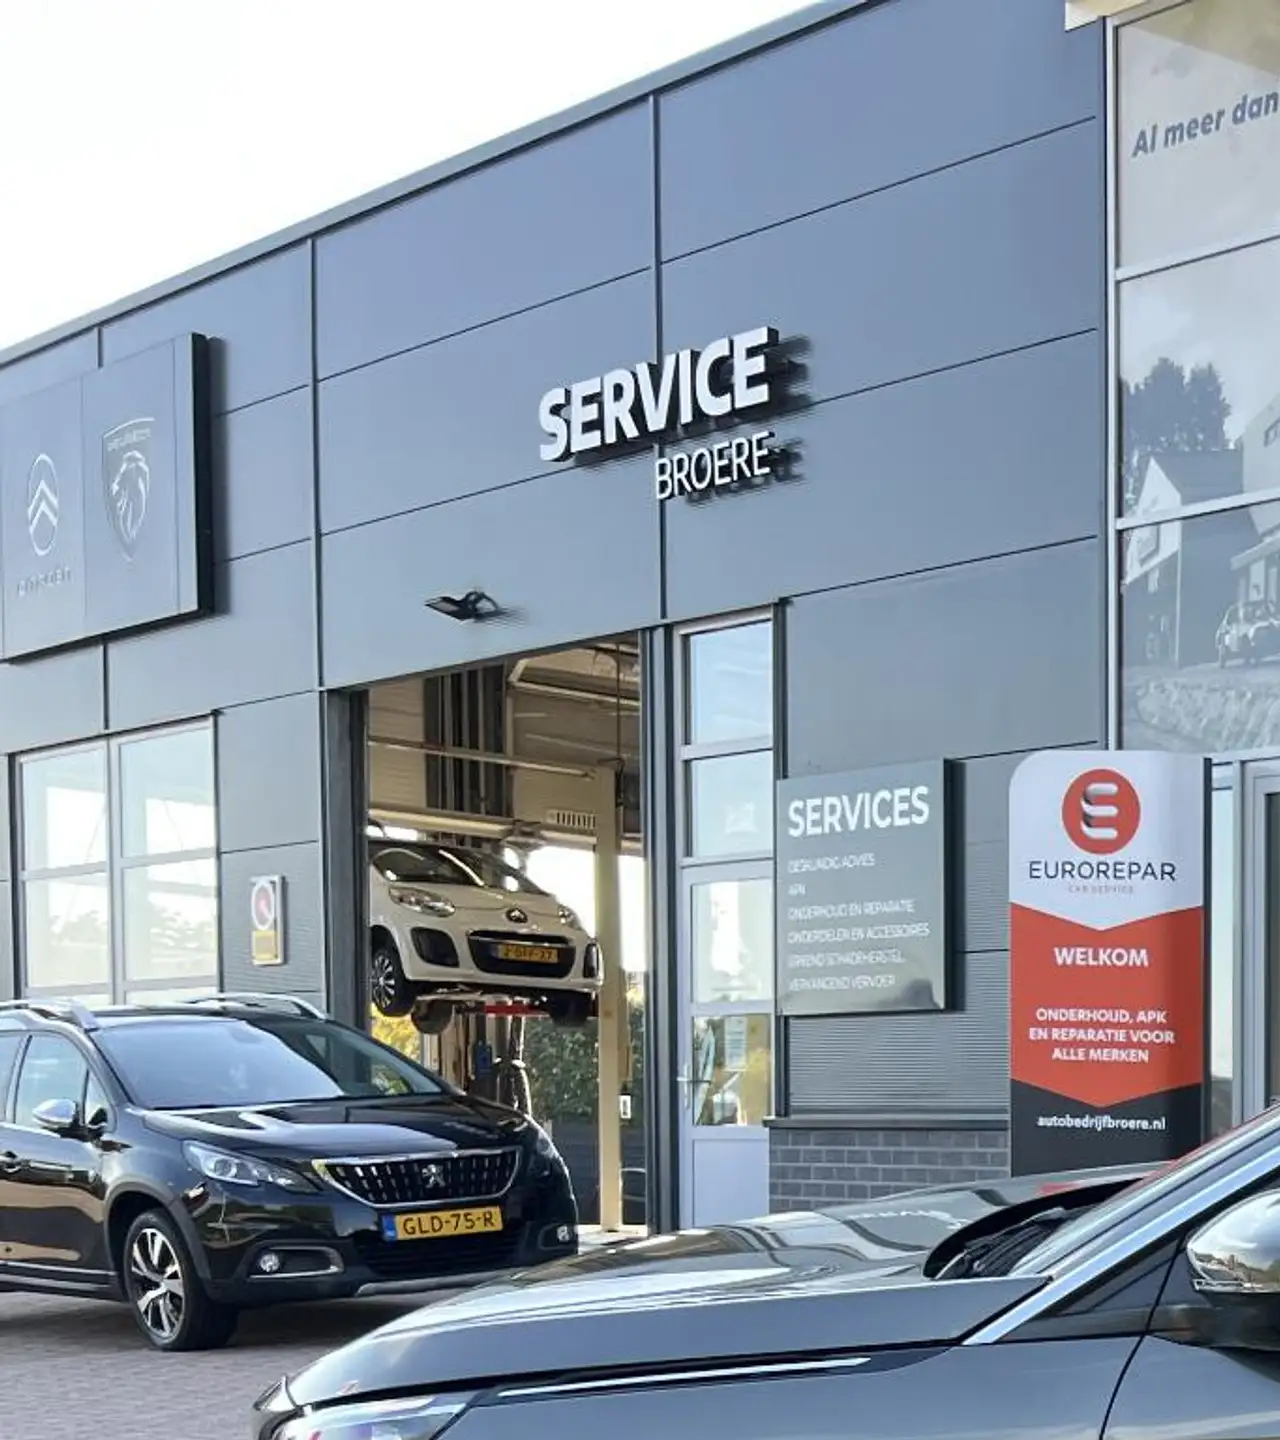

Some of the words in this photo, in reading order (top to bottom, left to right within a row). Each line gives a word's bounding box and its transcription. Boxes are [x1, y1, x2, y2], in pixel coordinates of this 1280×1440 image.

[1131, 124, 1158, 158] Al
[1163, 108, 1226, 149] meer
[1232, 91, 1280, 126] dan
[538, 326, 777, 462] SERVICE
[655, 430, 772, 500] BROERE
[788, 785, 930, 838] SERVICES
[1029, 860, 1177, 882] EUROREPAR
[1054, 947, 1149, 967] WELKOM
[1036, 1007, 1133, 1024] ONDERHOUD,
[1136, 1010, 1168, 1025] APK
[1029, 1027, 1048, 1041] EN
[1051, 1028, 1127, 1043] REPARATIE
[1129, 1030, 1176, 1044] VOOR
[1052, 1047, 1086, 1062] ALLE
[1089, 1048, 1149, 1064] MERKEN
[1037, 1114, 1166, 1131] autobedrijfbroere.nl
[403, 1210, 495, 1236] GLD-75-R
